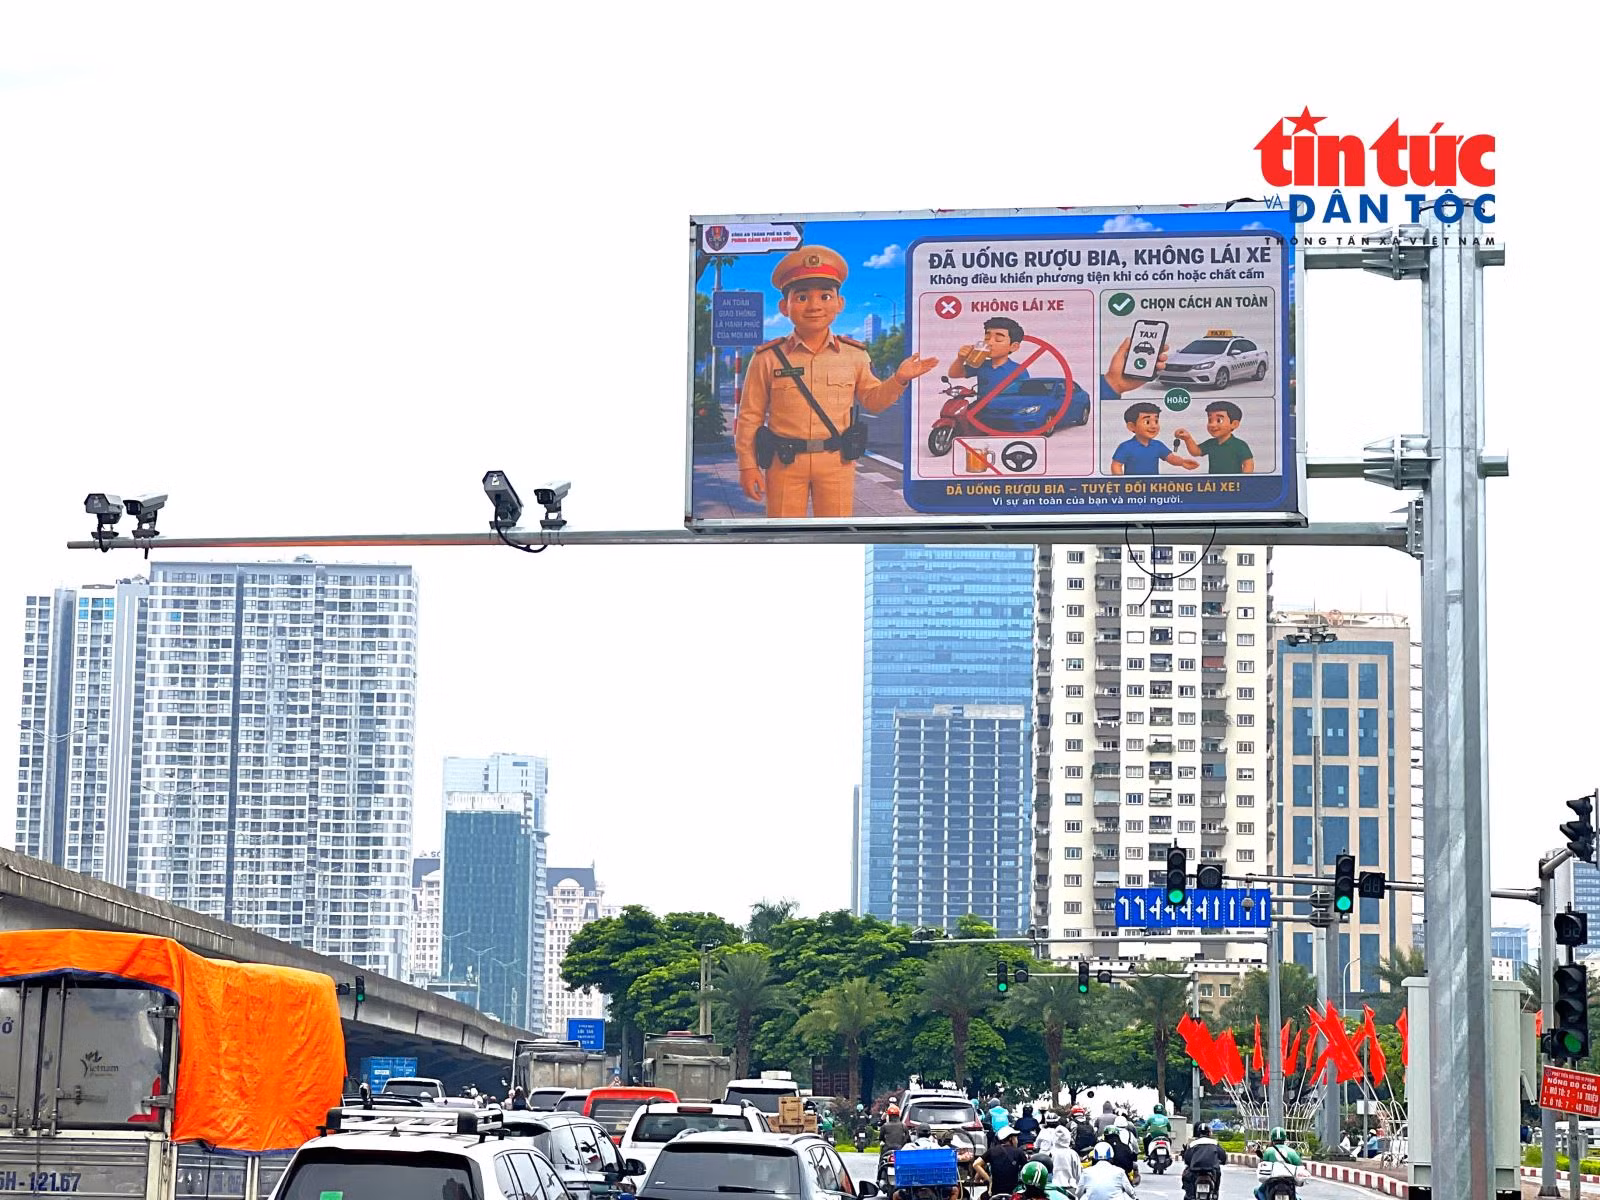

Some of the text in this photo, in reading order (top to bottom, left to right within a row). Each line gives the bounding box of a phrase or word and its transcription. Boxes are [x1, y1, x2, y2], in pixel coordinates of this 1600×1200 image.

[928, 244, 1272, 270] ĐÃ UỐNG RƯỢU BIA, KHÔNG LÁI XE
[930, 274, 968, 286] Không
[971, 272, 997, 284] điều
[1000, 272, 1033, 284] khiển
[1036, 272, 1084, 285] phương
[1087, 271, 1110, 284] tiện
[1114, 271, 1132, 282] khi
[1134, 270, 1148, 282] có
[1177, 270, 1206, 282] hoặc
[1210, 268, 1236, 280] chất
[1239, 268, 1264, 280] cấm
[971, 298, 1064, 312] KHÔNG LÁI XE
[1140, 294, 1268, 311] CHỌN CÁCH AN TOÀN
[1140, 330, 1158, 339] TAXI
[1166, 394, 1188, 405] HOẶC
[946, 483, 962, 495] ĐÃ
[966, 482, 1001, 494] UỐNG
[1005, 484, 1040, 496] RƯỢU
[1044, 484, 1065, 494] BIA
[1081, 482, 1120, 495] TUYỆT
[1125, 480, 1146, 493] ĐỐI
[1150, 481, 1193, 492] KHÔNG
[1198, 480, 1216, 492] LÁI
[1220, 482, 1240, 492] XE!
[1006, 497, 1019, 508] sự
[1039, 496, 1062, 505] toàn
[1066, 496, 1084, 505] của
[1088, 496, 1108, 506] bạn
[1111, 496, 1124, 504] và
[1127, 496, 1146, 505] mọi
[1150, 494, 1184, 505] người.
[29, 1172, 82, 1192] 121.67
